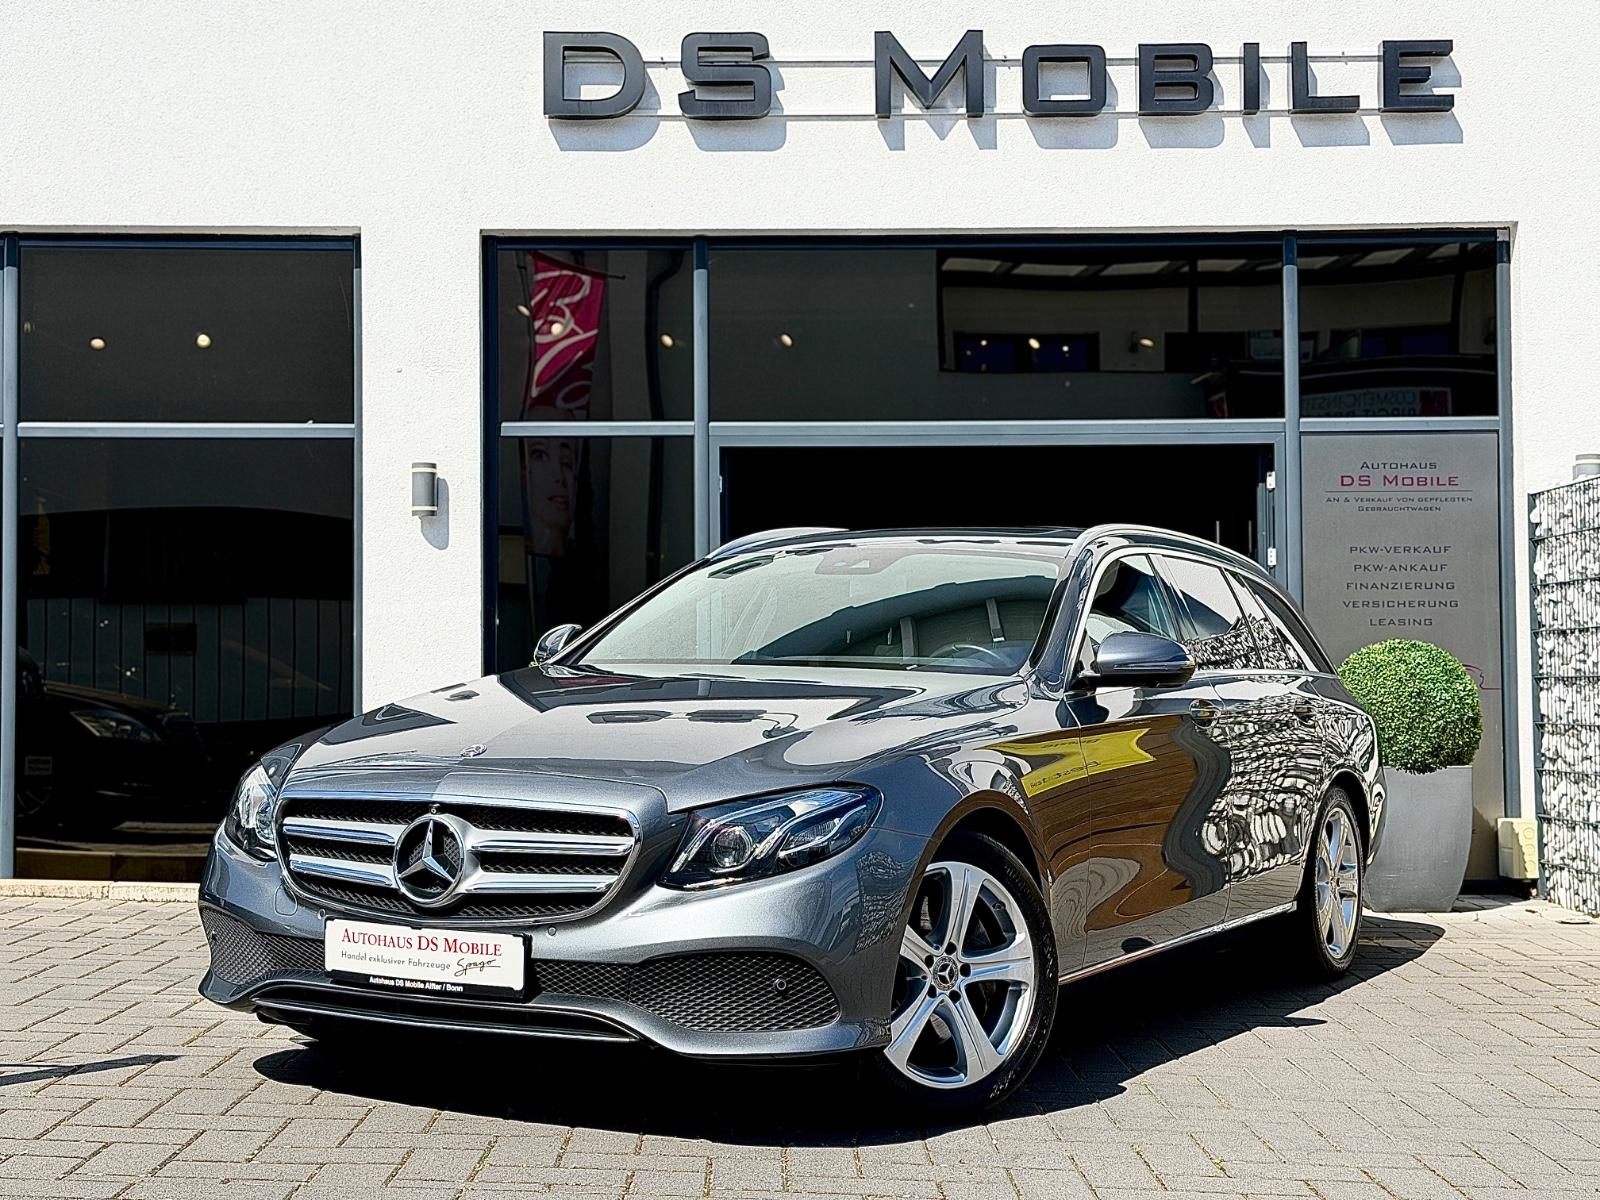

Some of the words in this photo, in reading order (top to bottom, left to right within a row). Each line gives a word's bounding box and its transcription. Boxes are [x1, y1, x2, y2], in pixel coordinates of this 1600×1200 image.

[543, 31, 771, 120] DS
[874, 29, 1455, 118] MOBILE
[1360, 461, 1437, 470] AUTOHAUS
[1340, 475, 1371, 487] DS
[1383, 475, 1459, 487] MOBILE
[1350, 546, 1452, 554] PKW-VERKAUF
[1354, 564, 1448, 572] PKW-ANKAUF
[1347, 582, 1455, 590] FINANZIERUNG
[1343, 600, 1458, 608] VERSICHERUNG
[1370, 618, 1433, 626] LEASING
[341, 928, 413, 949] AUTOHAUS
[417, 935, 439, 951] DS
[443, 938, 502, 957] MOBILE
[341, 951, 367, 962] Handel
[369, 955, 406, 966] exklusiver
[408, 958, 451, 970] Fahrzeuge
[395, 979, 404, 987] DS
[405, 980, 425, 989] Mobile
[446, 983, 464, 992] Bonn
